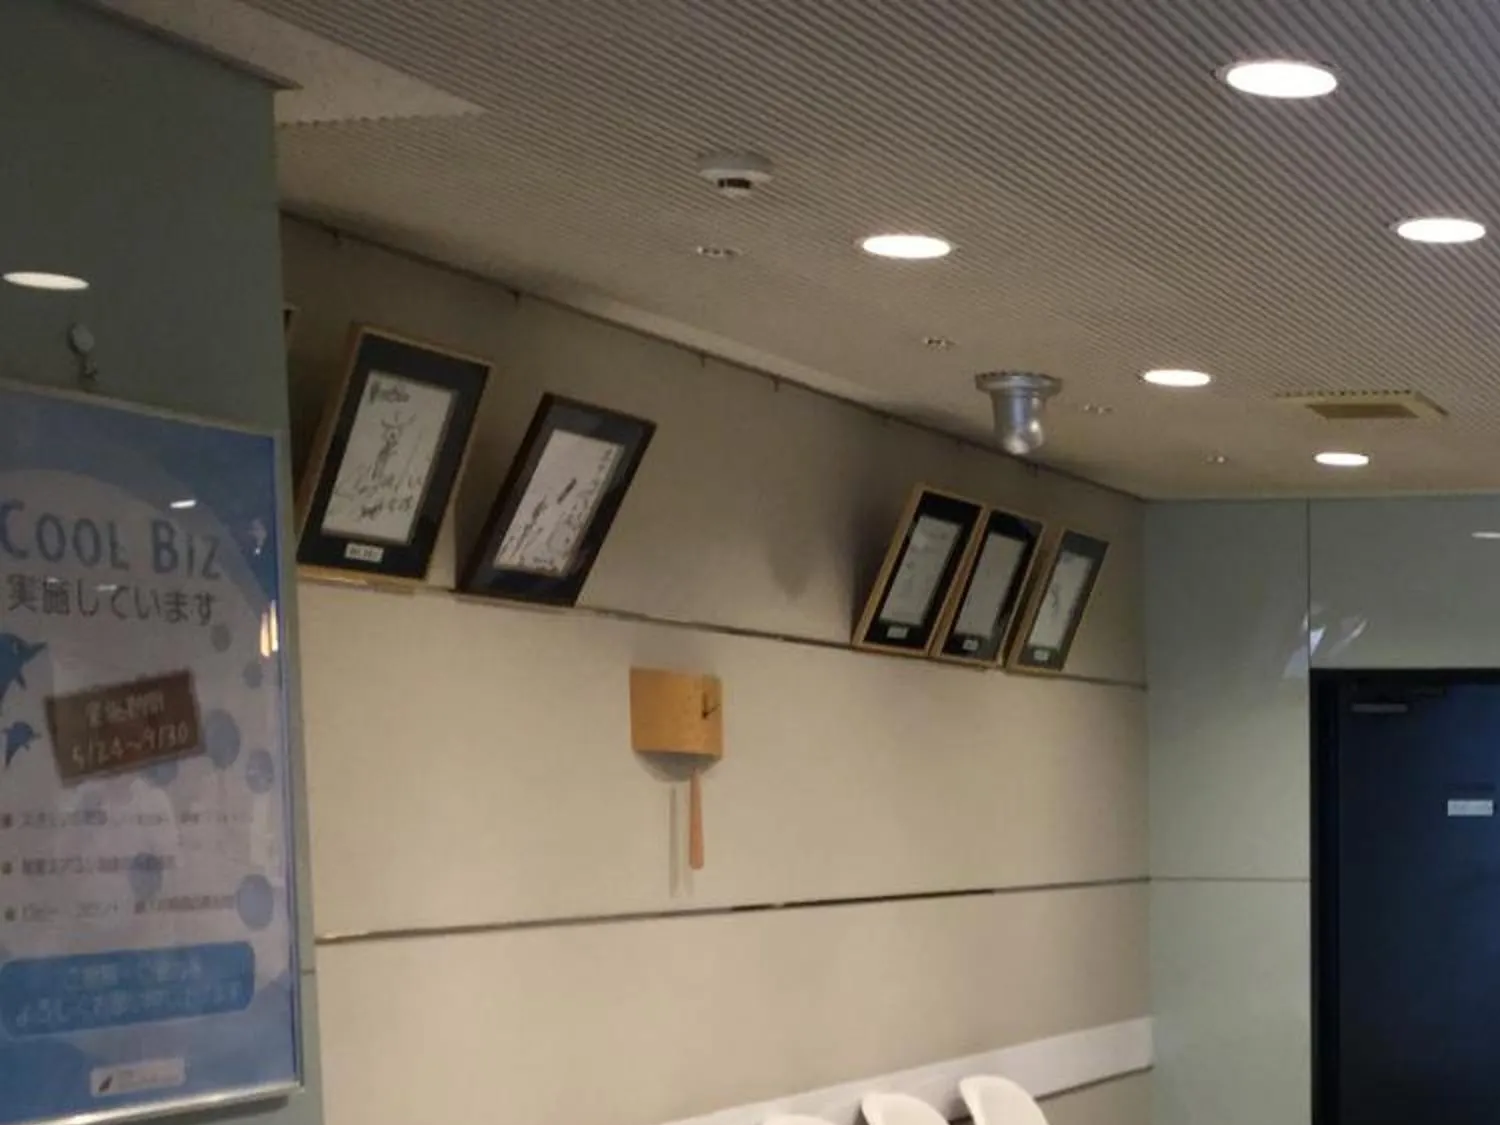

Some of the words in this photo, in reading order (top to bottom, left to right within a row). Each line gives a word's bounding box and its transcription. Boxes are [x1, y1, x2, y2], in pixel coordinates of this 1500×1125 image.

[0, 498, 130, 571] COOL
[6, 572, 217, 626] 実施しています
